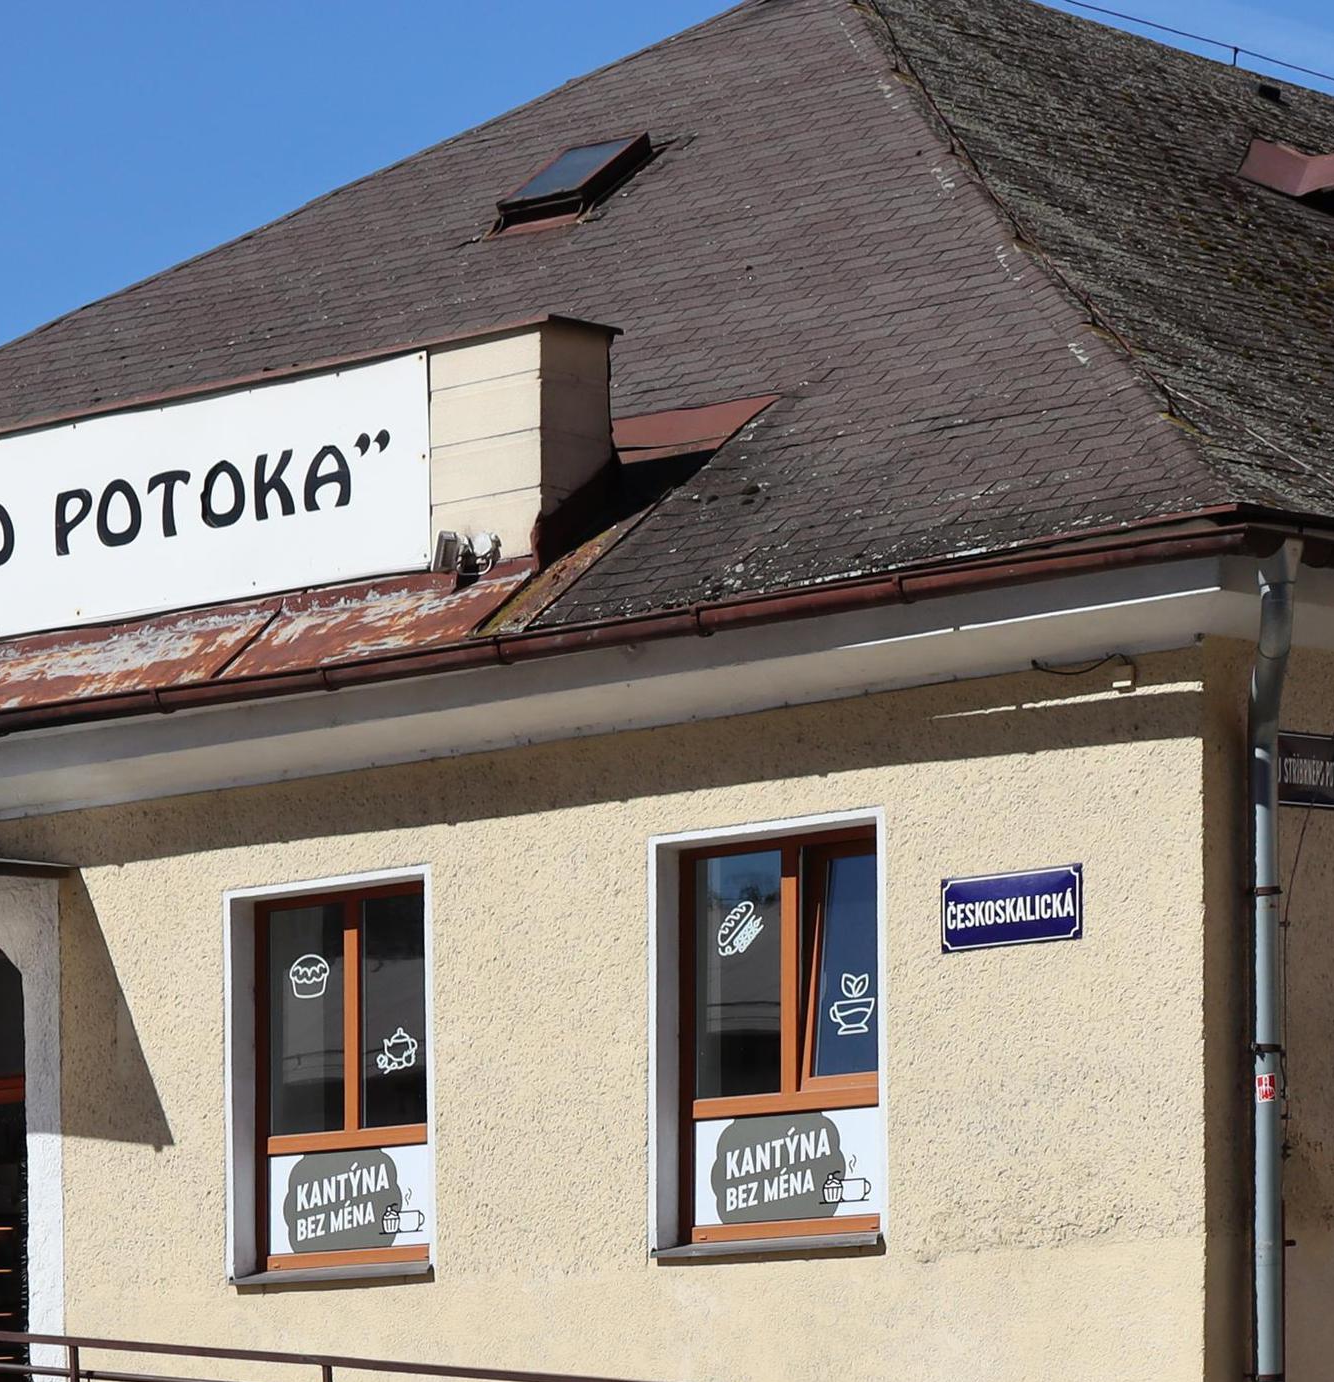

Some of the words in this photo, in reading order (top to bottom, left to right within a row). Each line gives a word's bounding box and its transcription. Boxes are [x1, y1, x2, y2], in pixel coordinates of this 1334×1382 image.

[946, 887, 1075, 931] ČESKOSKALICKÁ
[726, 1126, 831, 1180] KANTÝNA
[297, 1162, 389, 1212] KANTÝNA
[726, 1181, 759, 1212] BEZ
[763, 1167, 815, 1203] MÉNA
[297, 1213, 326, 1242] BEZ
[330, 1200, 375, 1233] MÉNA
